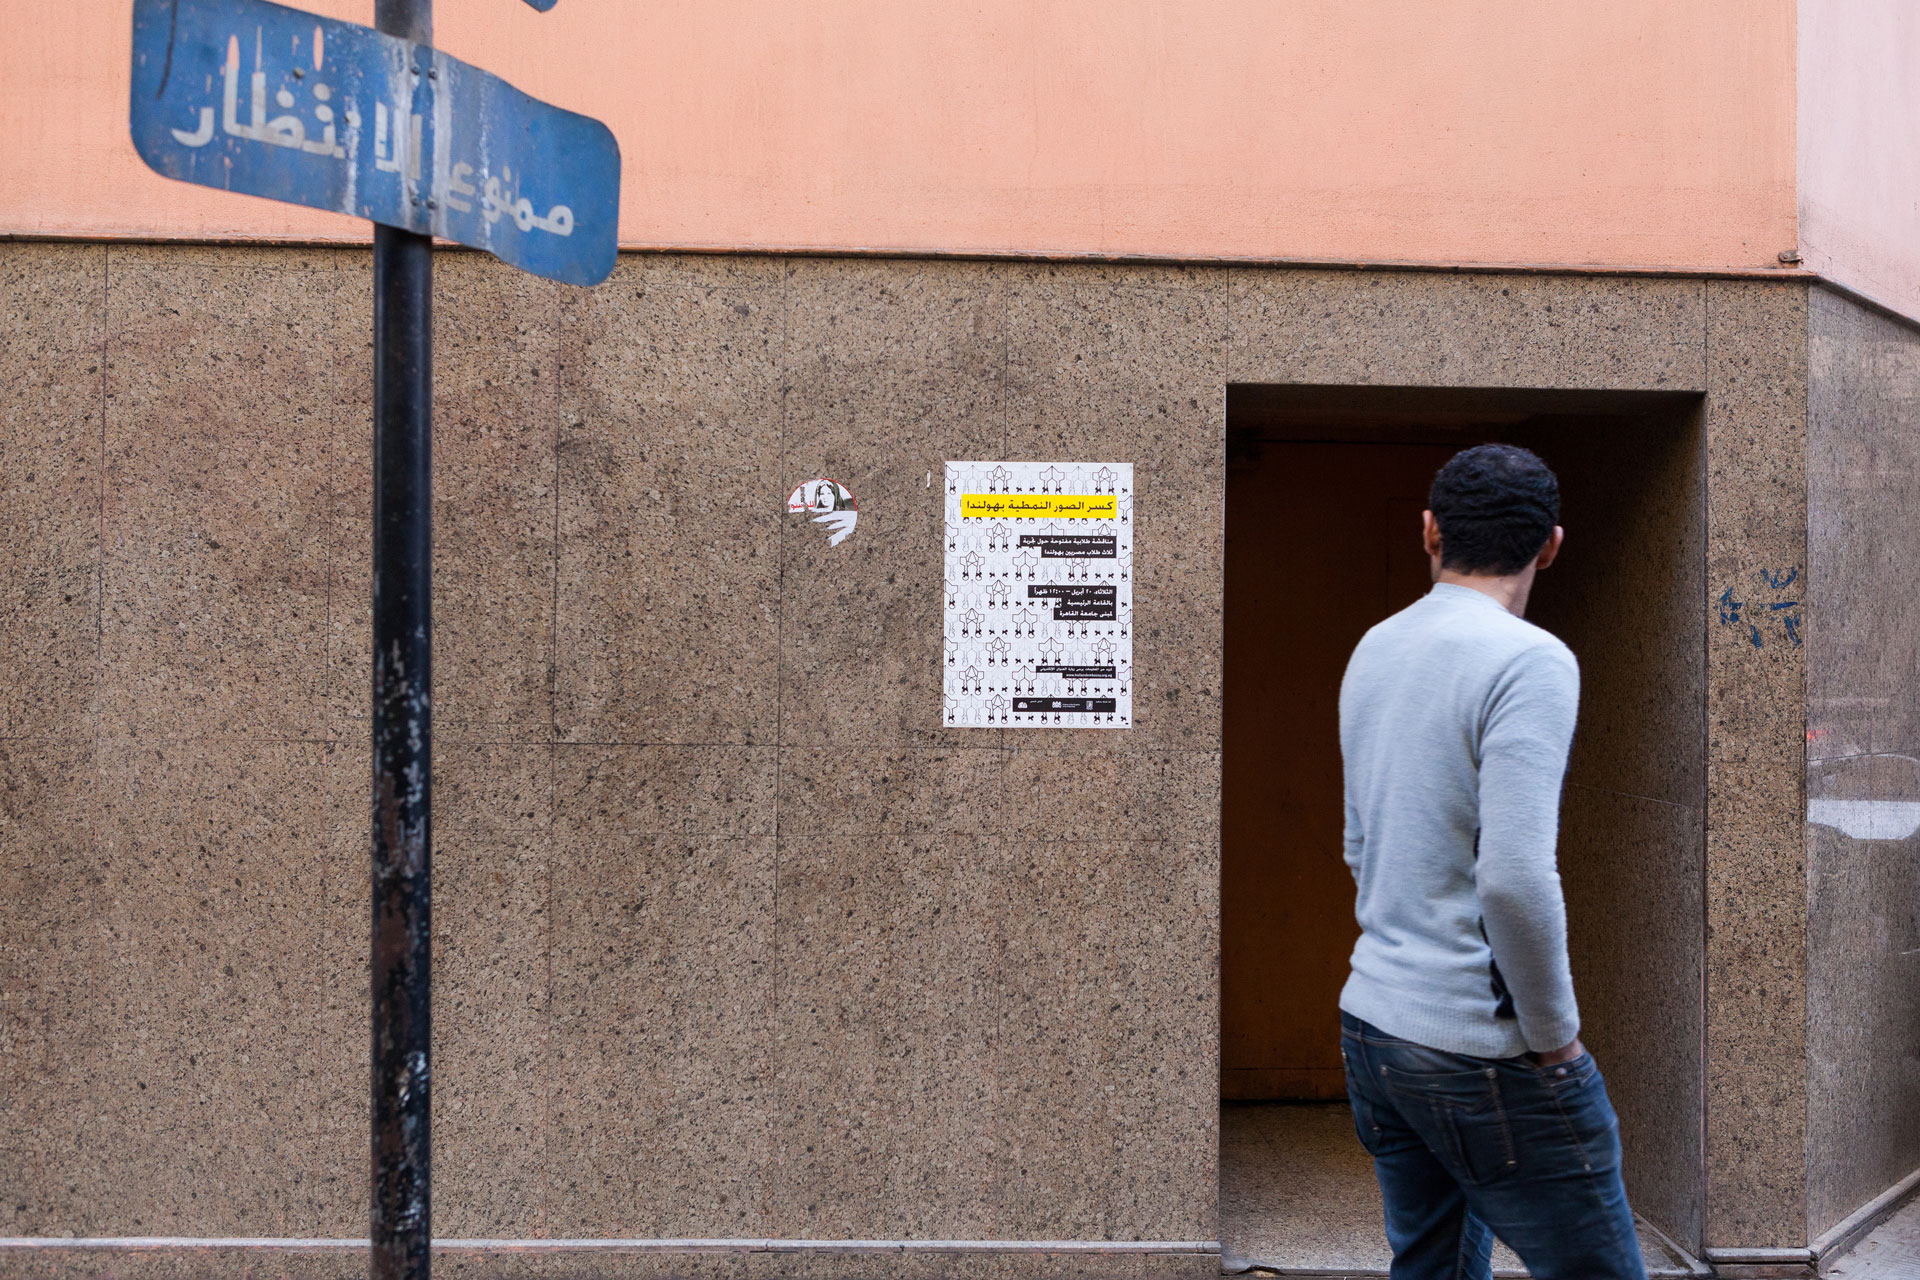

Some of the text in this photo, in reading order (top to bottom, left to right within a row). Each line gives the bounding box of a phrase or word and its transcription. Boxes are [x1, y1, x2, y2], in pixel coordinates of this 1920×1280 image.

[171, 58, 575, 237] ممنوع الانتظار
[967, 499, 1113, 513] كسر الصور النمطية بهولندا
[1050, 537, 1072, 545] مفتوحة
[1073, 538, 1091, 546] طلابية
[1067, 599, 1113, 607] بالقاعة الرئيسية
[1059, 610, 1079, 618] القاهرة
